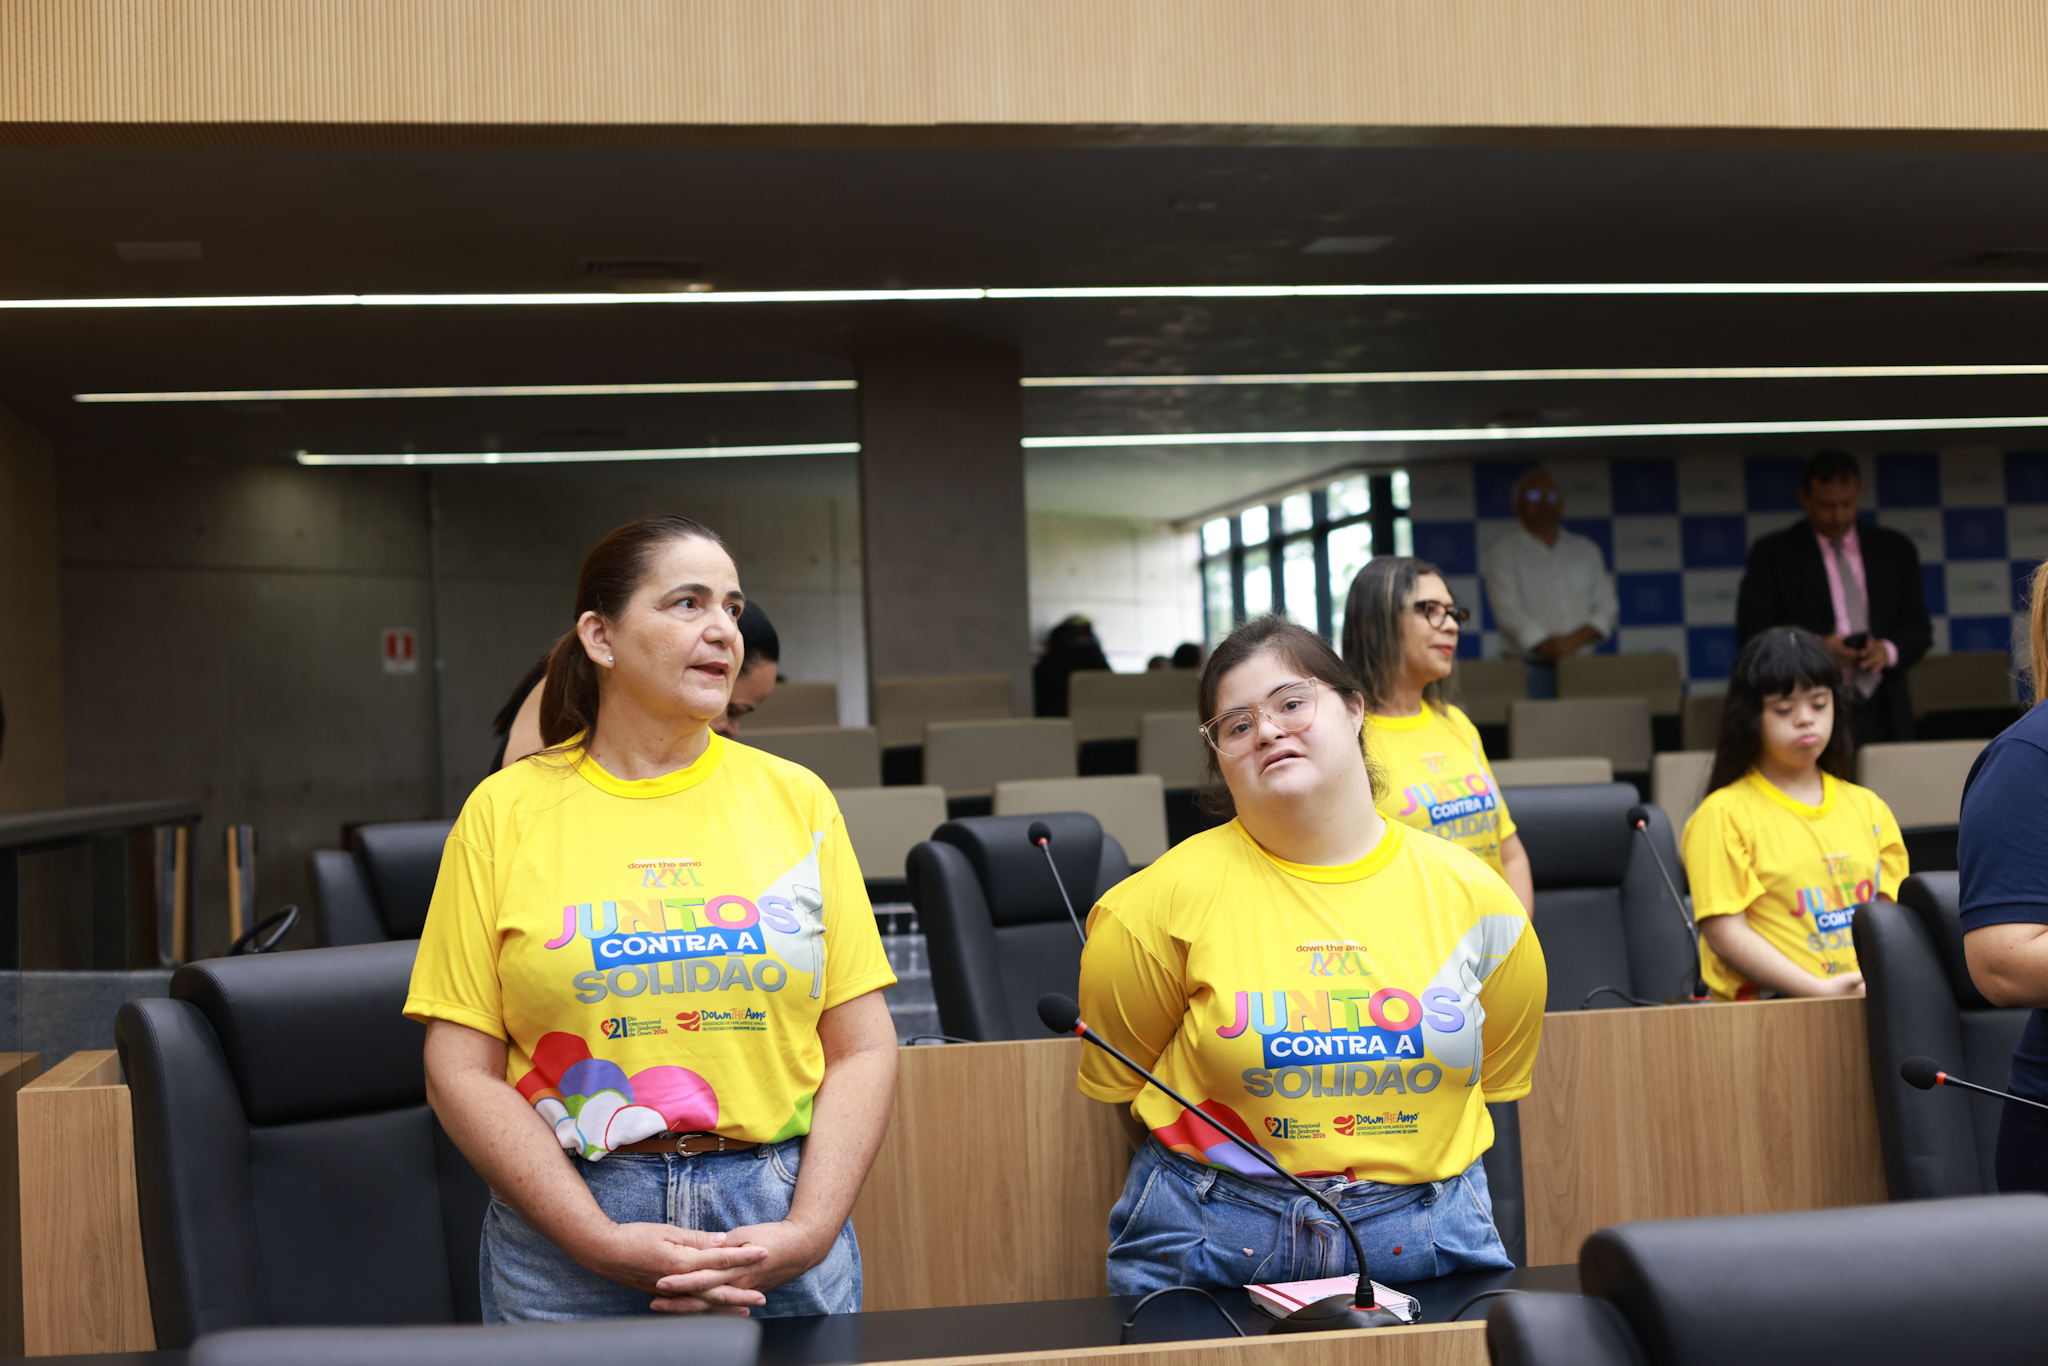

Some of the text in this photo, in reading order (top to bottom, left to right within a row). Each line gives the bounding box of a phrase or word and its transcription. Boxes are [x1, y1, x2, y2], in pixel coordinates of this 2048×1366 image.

[1431, 795, 1494, 820] CONTRA A
[635, 856, 693, 865] caminhada
[1789, 879, 1878, 918] JUNTO
[544, 894, 802, 950] JUNTOS
[1818, 908, 1856, 928] CONT
[600, 932, 759, 958] CONTRA A
[1303, 939, 1359, 947] caminhada
[1326, 944, 1343, 952] the
[572, 952, 787, 1004] SOLIDÃO
[628, 1018, 662, 1027] Internacional
[1216, 986, 1465, 1039] JUNTOS
[608, 1017, 628, 1040] 21
[1270, 1034, 1416, 1058] CONTRA A
[1241, 1056, 1442, 1099] SOLIDÃO
[1271, 1117, 1289, 1139] 21
